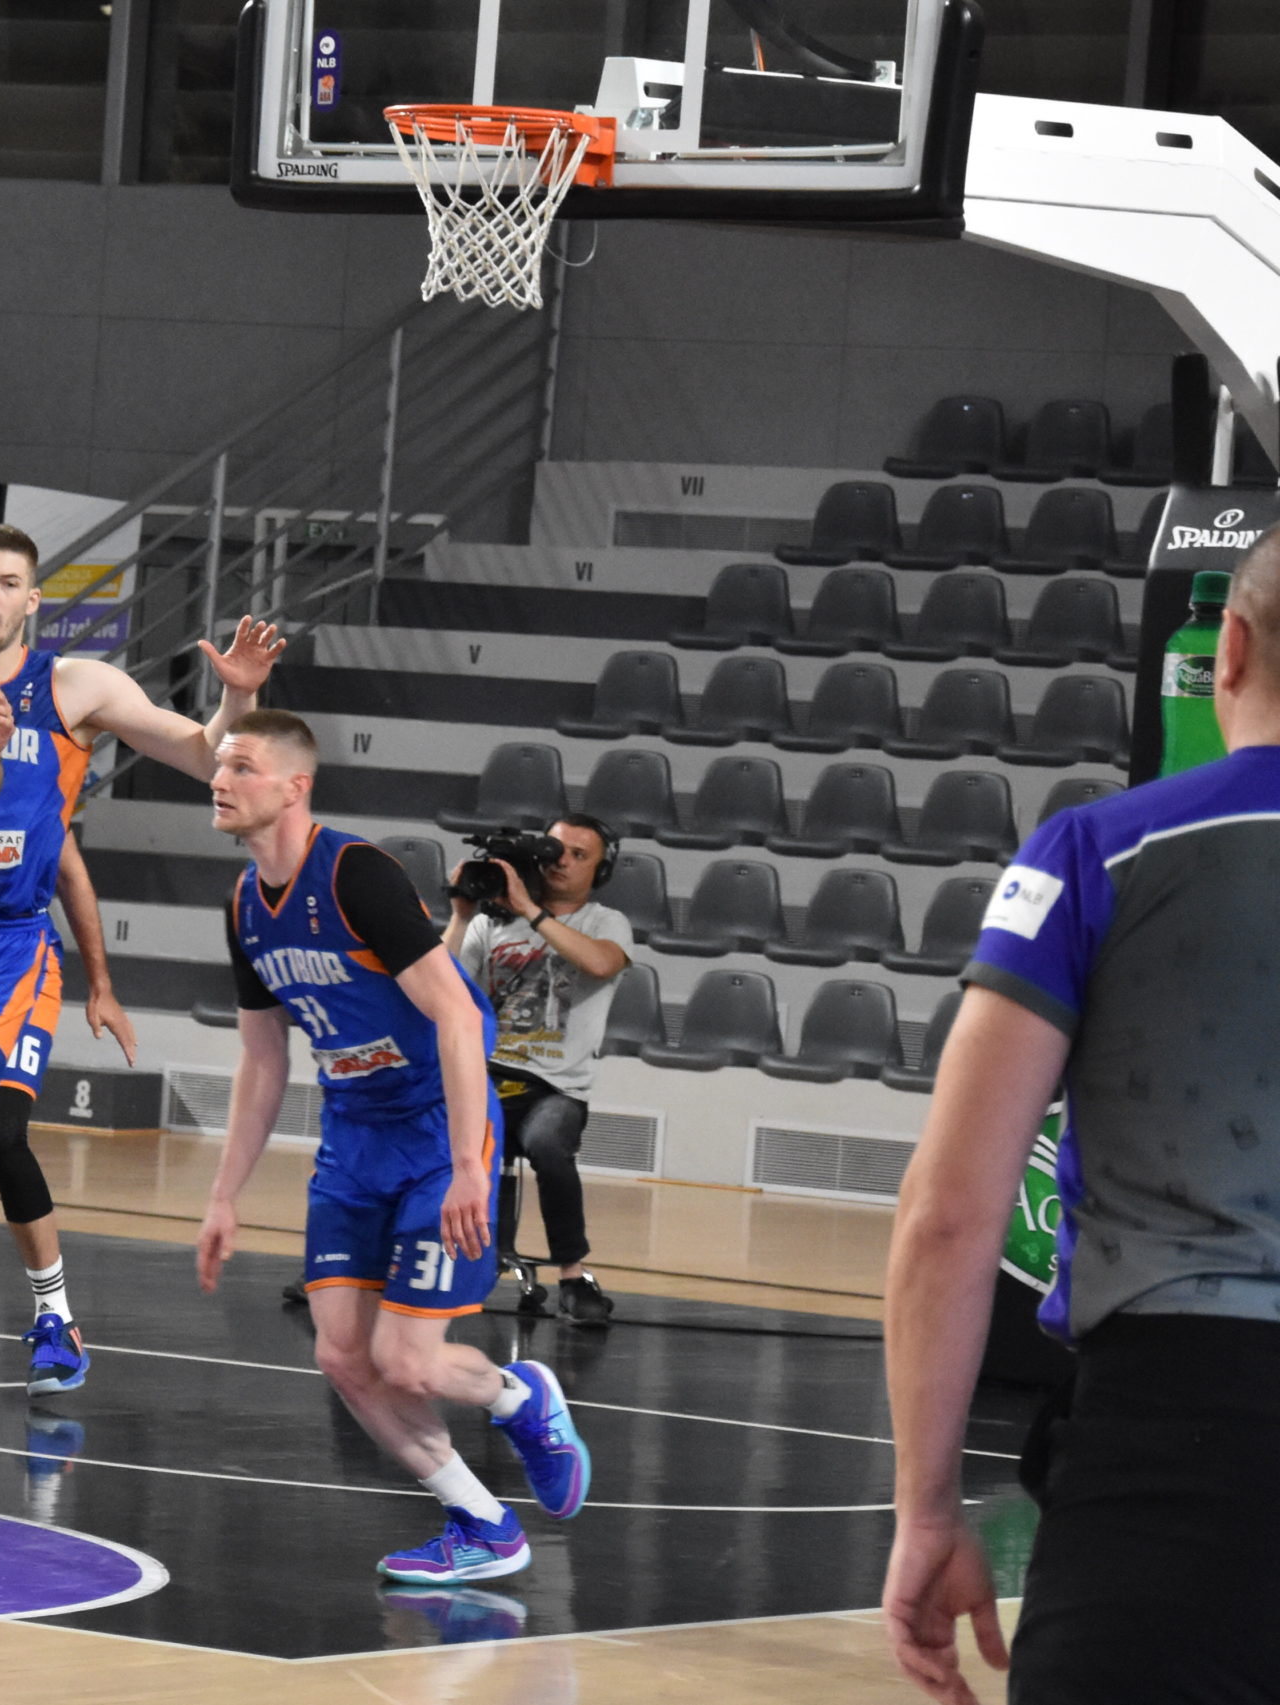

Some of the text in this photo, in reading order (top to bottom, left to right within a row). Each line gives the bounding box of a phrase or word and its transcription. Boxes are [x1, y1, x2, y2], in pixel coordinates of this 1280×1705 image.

[317, 58, 336, 68] NLB
[276, 162, 338, 179] SPALDING
[681, 476, 704, 496] VII
[1167, 525, 1264, 550] SPALDIN
[575, 562, 593, 581] VI
[470, 644, 482, 665] V
[353, 733, 372, 754] IV
[75, 1079, 91, 1107] 8
[409, 1240, 458, 1292] 31
